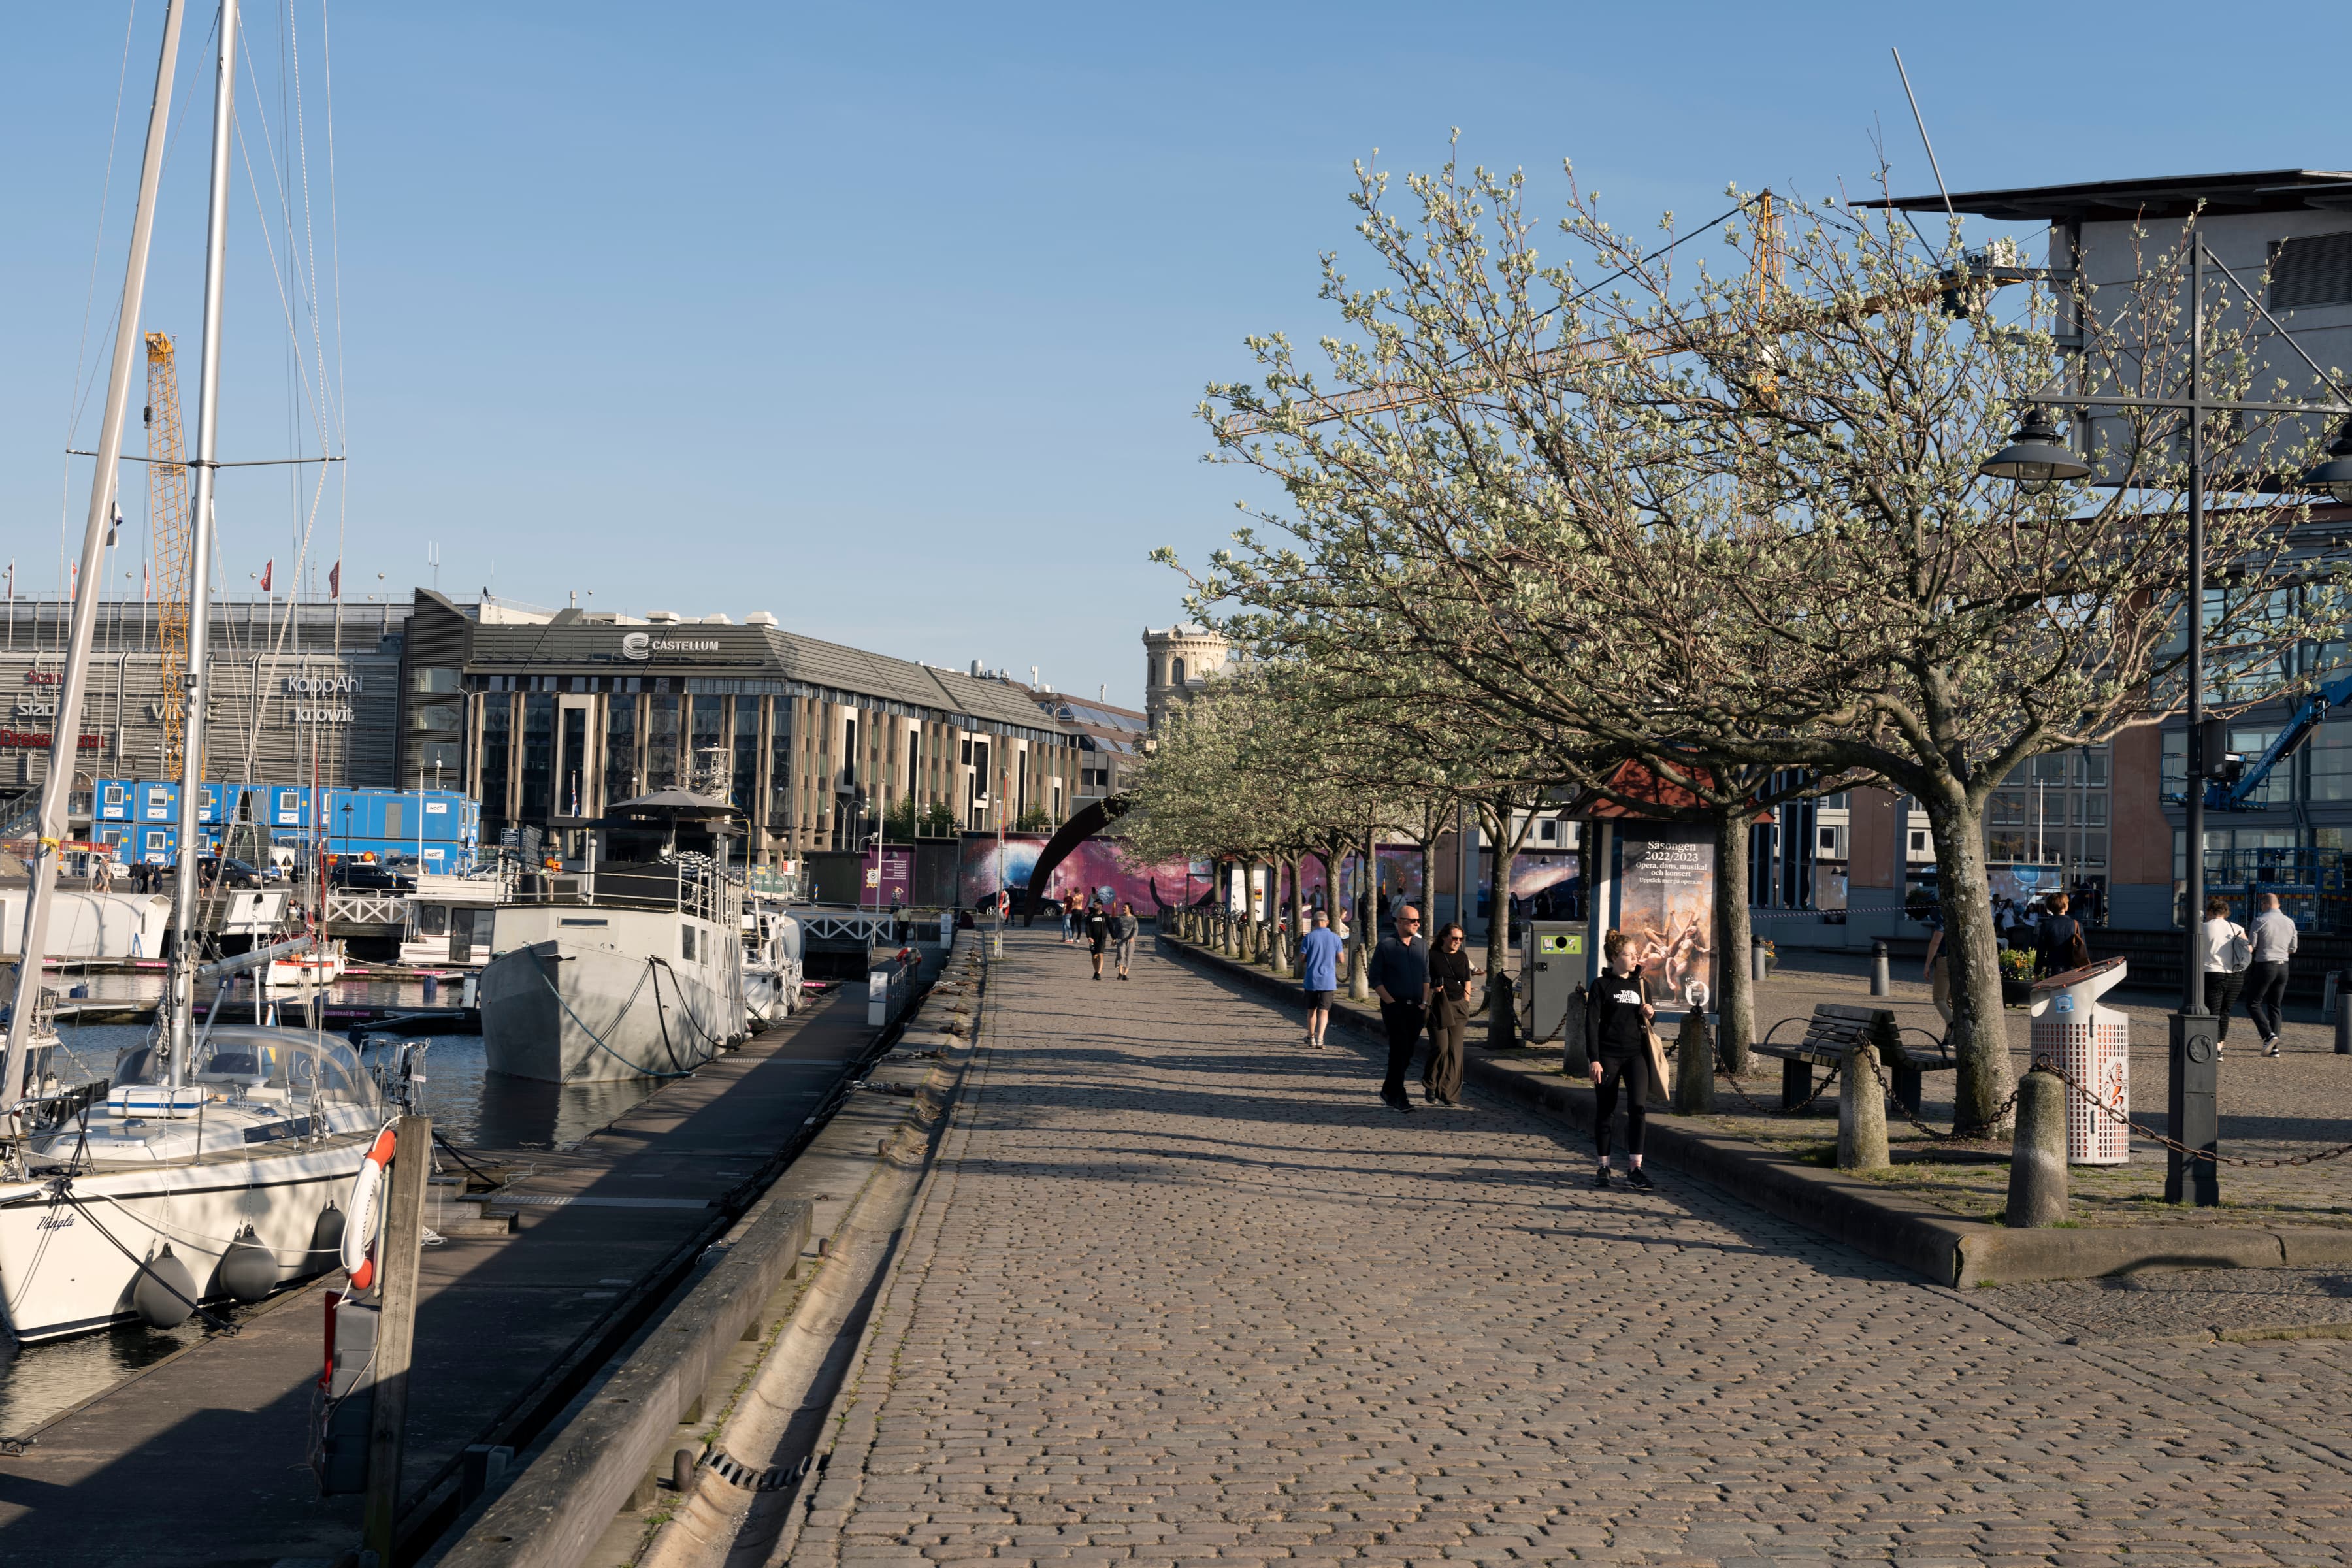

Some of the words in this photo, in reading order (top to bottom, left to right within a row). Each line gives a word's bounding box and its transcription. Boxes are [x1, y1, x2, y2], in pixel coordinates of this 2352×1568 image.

[652, 640, 719, 651] CASTELLUM
[28, 670, 63, 684] Scan
[288, 674, 363, 696] KappAhl
[151, 703, 221, 720] VINE
[295, 706, 354, 722] knowit
[2251, 723, 2295, 777] kranpunkten.com
[1648, 840, 1697, 853] Säsongen
[1644, 851, 1699, 862] 2022/2023
